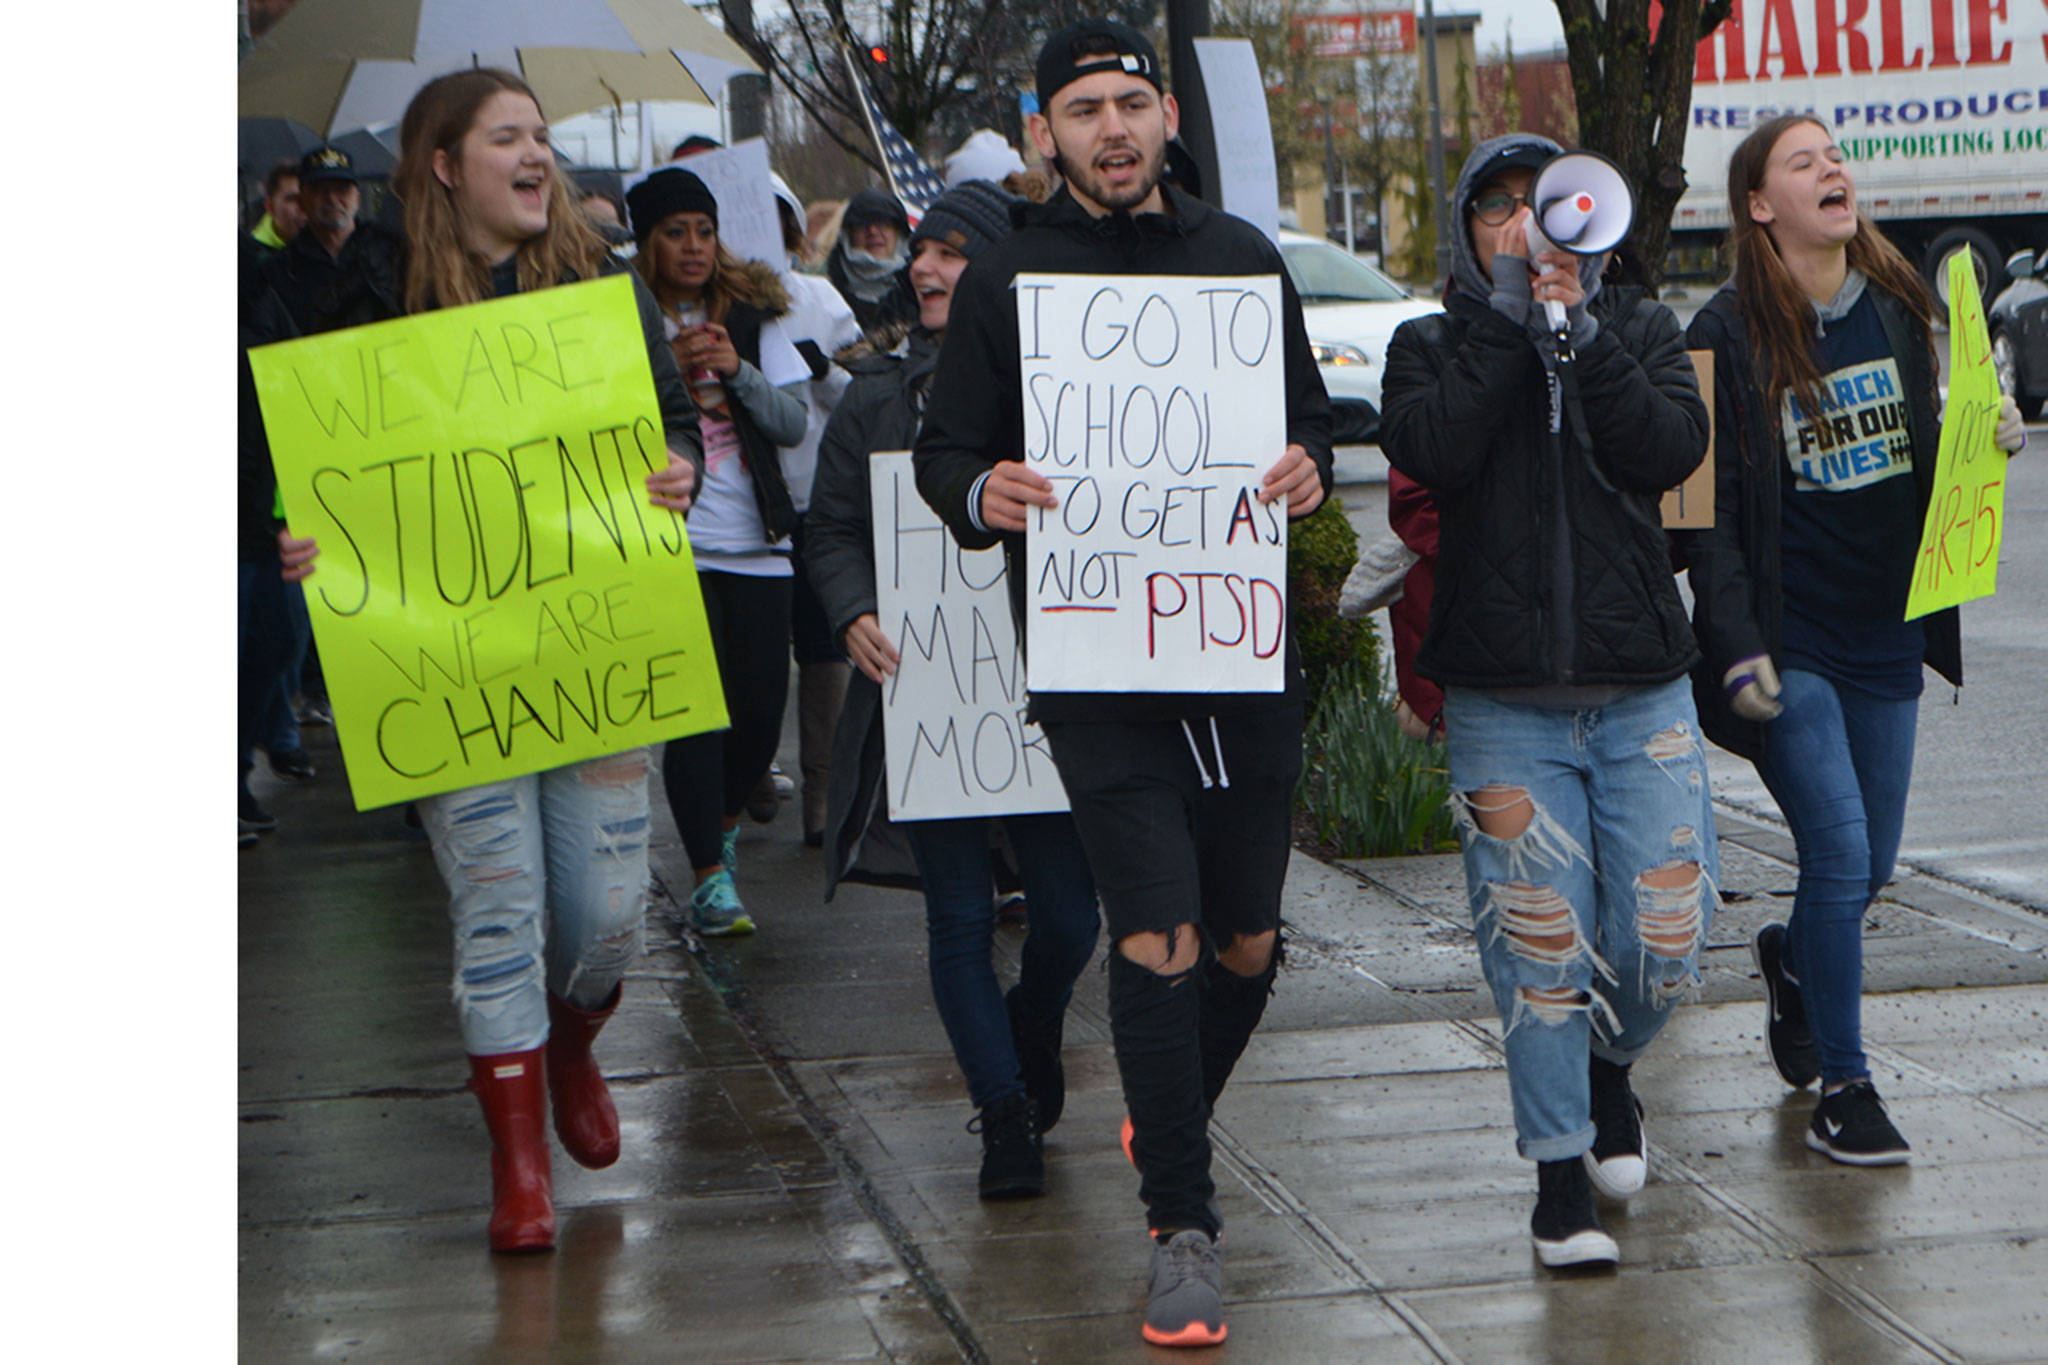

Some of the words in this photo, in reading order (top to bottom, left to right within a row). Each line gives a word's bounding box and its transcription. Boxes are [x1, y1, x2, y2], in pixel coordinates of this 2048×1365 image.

[1840, 128, 1994, 163] SUPPORTING
[292, 339, 423, 440] WE
[455, 311, 605, 414] ARE
[1022, 284, 1055, 360] I
[1081, 286, 1180, 368] GO
[1197, 287, 1273, 370] TO
[1027, 372, 1256, 476] SCHOOL
[1801, 439, 1890, 485] LIVES
[311, 415, 683, 618] STUDENTS
[1036, 476, 1102, 536] TO
[1120, 480, 1219, 551] GET
[1914, 479, 2002, 593] AR-15
[369, 606, 523, 693] WE
[534, 581, 655, 666] ARE
[1038, 548, 1139, 602] NOT
[1144, 571, 1285, 661] PTSD
[376, 650, 691, 780] CHANGE
